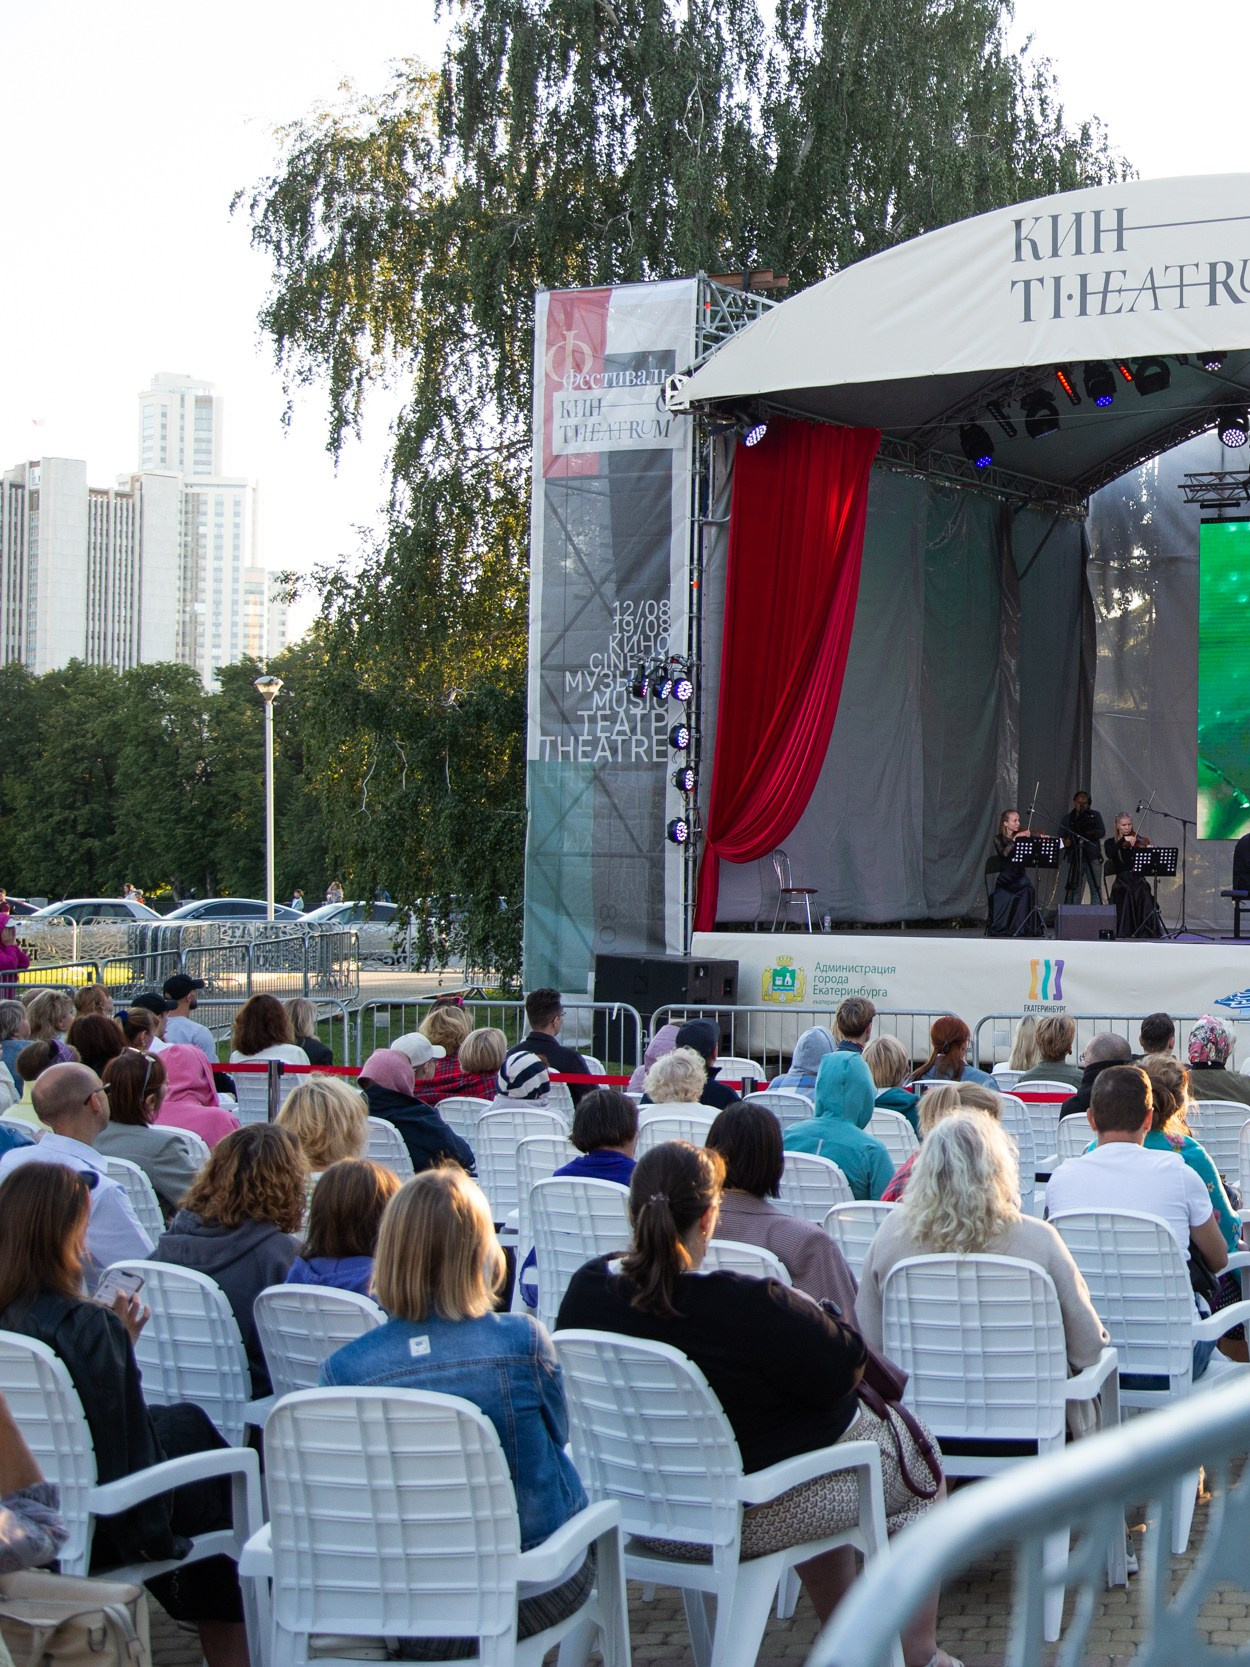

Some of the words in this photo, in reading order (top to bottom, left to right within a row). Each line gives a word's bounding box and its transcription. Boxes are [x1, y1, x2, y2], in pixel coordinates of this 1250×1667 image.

[612, 600, 671, 622] 12/08
[612, 617, 671, 639] 19/08
[609, 635, 670, 654] КИНО
[590, 652, 669, 672] CINE
[565, 669, 668, 692] МУЗЫ
[576, 710, 669, 737] ТЕАТР
[539, 735, 669, 762] THEATRE
[814, 961, 897, 976] Администрация
[813, 975, 849, 986] города
[812, 985, 888, 999] Екатеринбурга
[1023, 1004, 1067, 1013] ЕКАТЕРИНБУРГ
